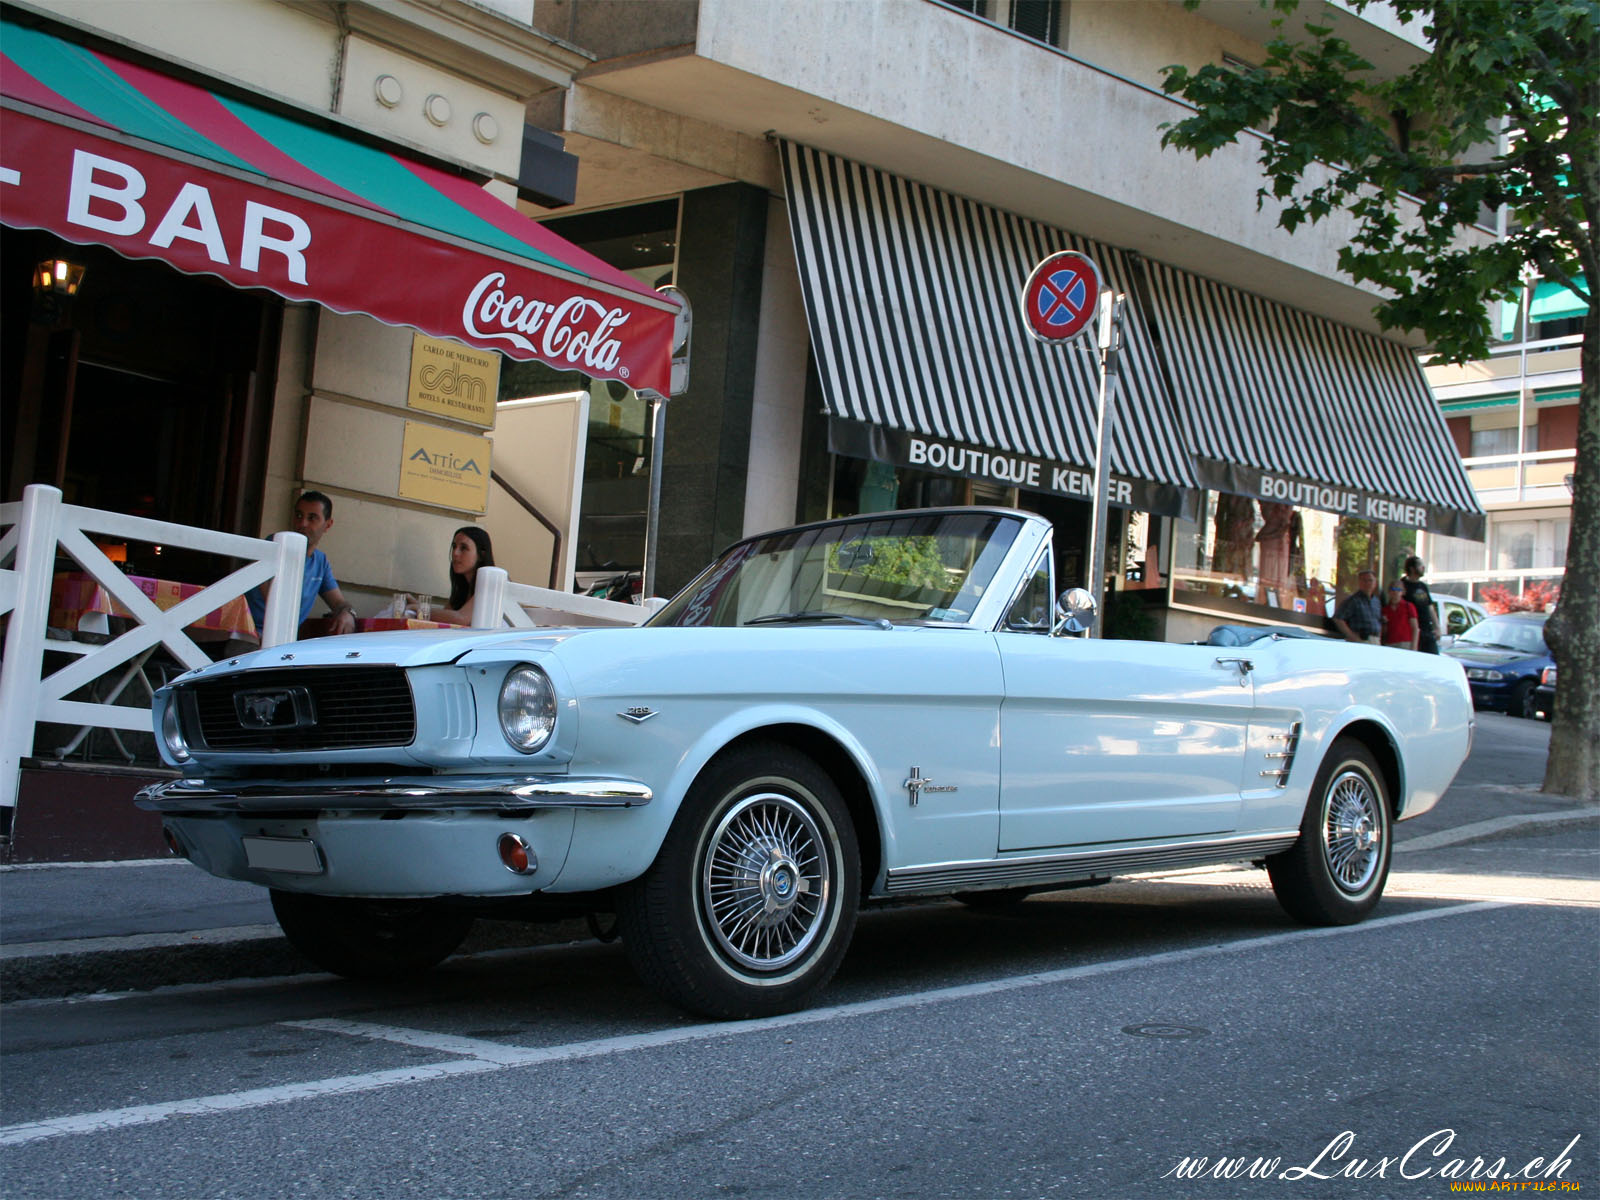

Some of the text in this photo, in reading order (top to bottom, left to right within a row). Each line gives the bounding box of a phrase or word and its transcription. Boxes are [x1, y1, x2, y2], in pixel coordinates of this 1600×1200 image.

[66, 149, 313, 286] BAR
[462, 271, 632, 372] Coca-Cola
[423, 344, 489, 368] CARLO DE MERCURIO
[418, 391, 440, 404] HOTELS
[447, 398, 485, 414] RESTAURANTS
[908, 438, 1042, 487] BOUTIQUE
[1260, 474, 1428, 528] BOUTIQUE KEMER
